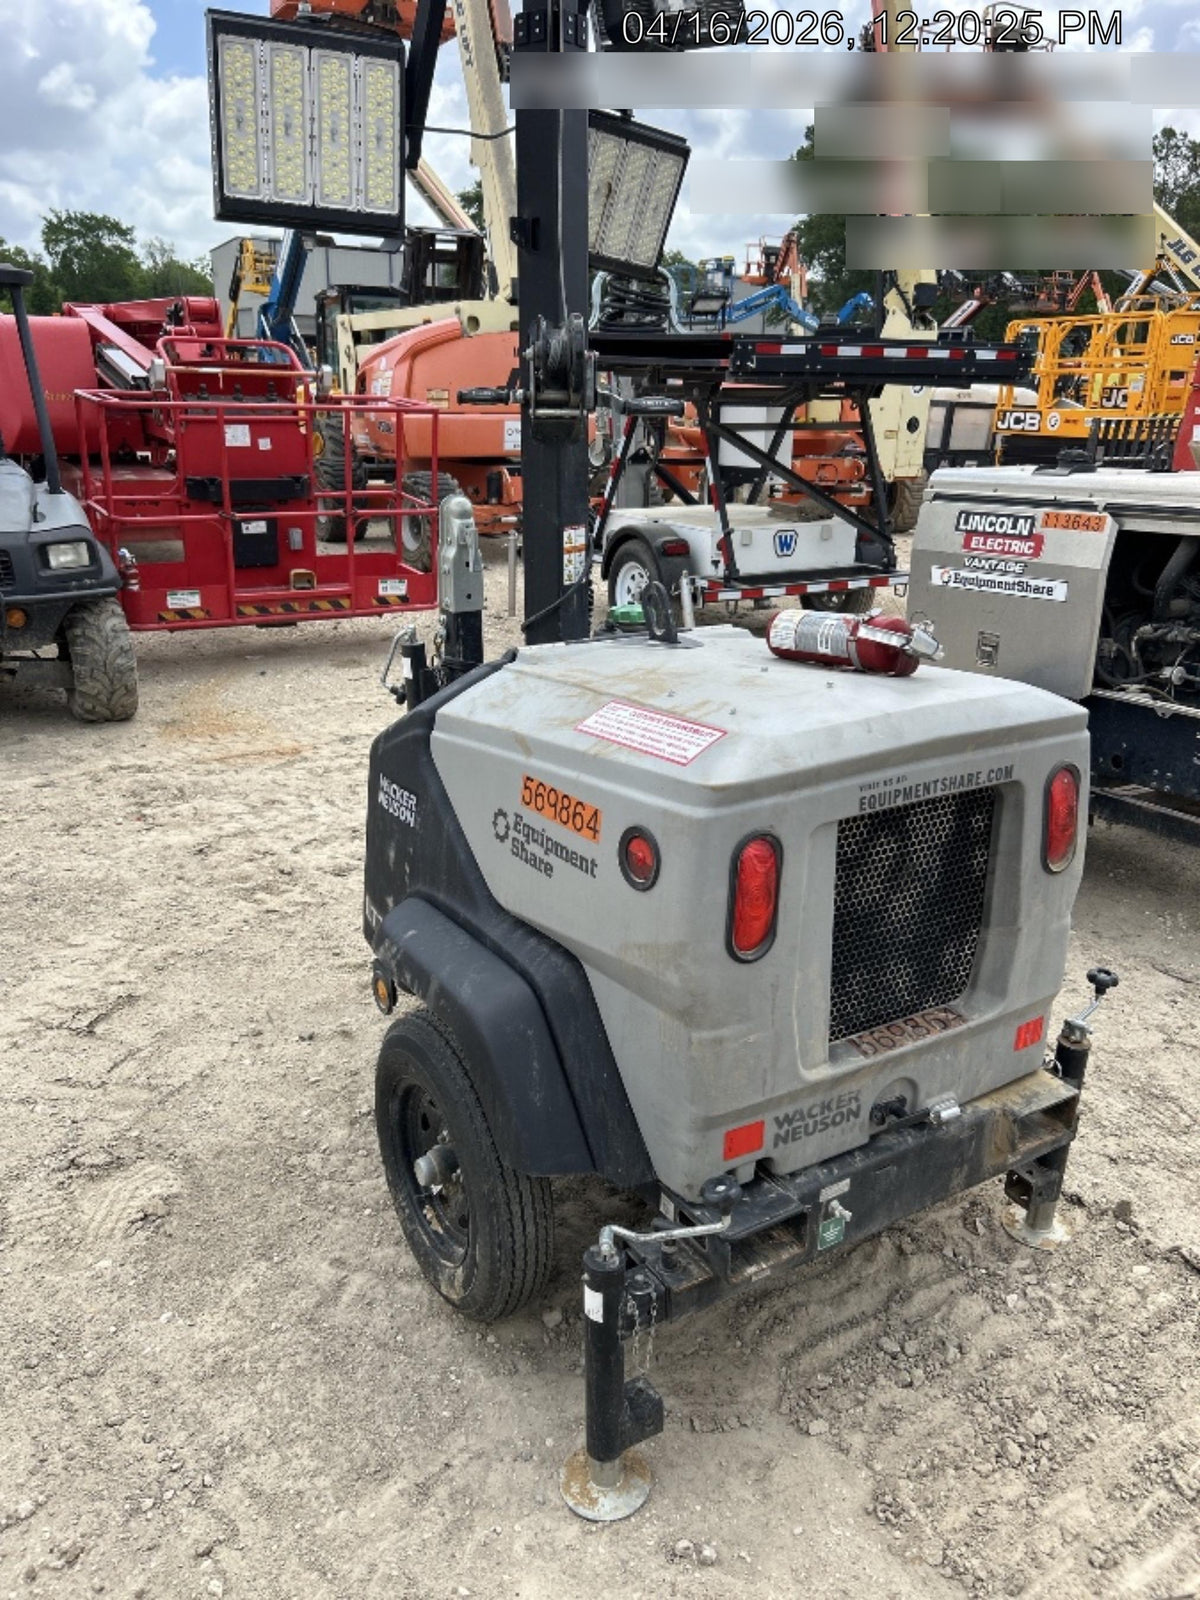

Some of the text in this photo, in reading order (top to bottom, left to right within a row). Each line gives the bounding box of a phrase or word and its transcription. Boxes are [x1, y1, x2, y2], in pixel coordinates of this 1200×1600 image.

[1166, 238, 1198, 265] JLG
[1170, 334, 1195, 345] JCB
[997, 411, 1041, 431] JCB
[958, 513, 1032, 536] LINCOLN
[1042, 512, 1103, 532] 113643
[778, 534, 795, 553] W
[969, 536, 1035, 554] ELECTRIC
[963, 557, 1026, 574] VANTAGE
[953, 572, 1054, 597] EquipmentShare
[379, 773, 417, 811] WACKER
[859, 764, 1015, 813] EQUIPMENTSHARE.COM
[378, 789, 416, 828] NEUSON
[521, 775, 600, 840] 569864
[511, 836, 554, 879] Share
[513, 812, 598, 879] Equipment
[773, 1089, 862, 1131] WACKER
[773, 1103, 862, 1149] NEUSON
